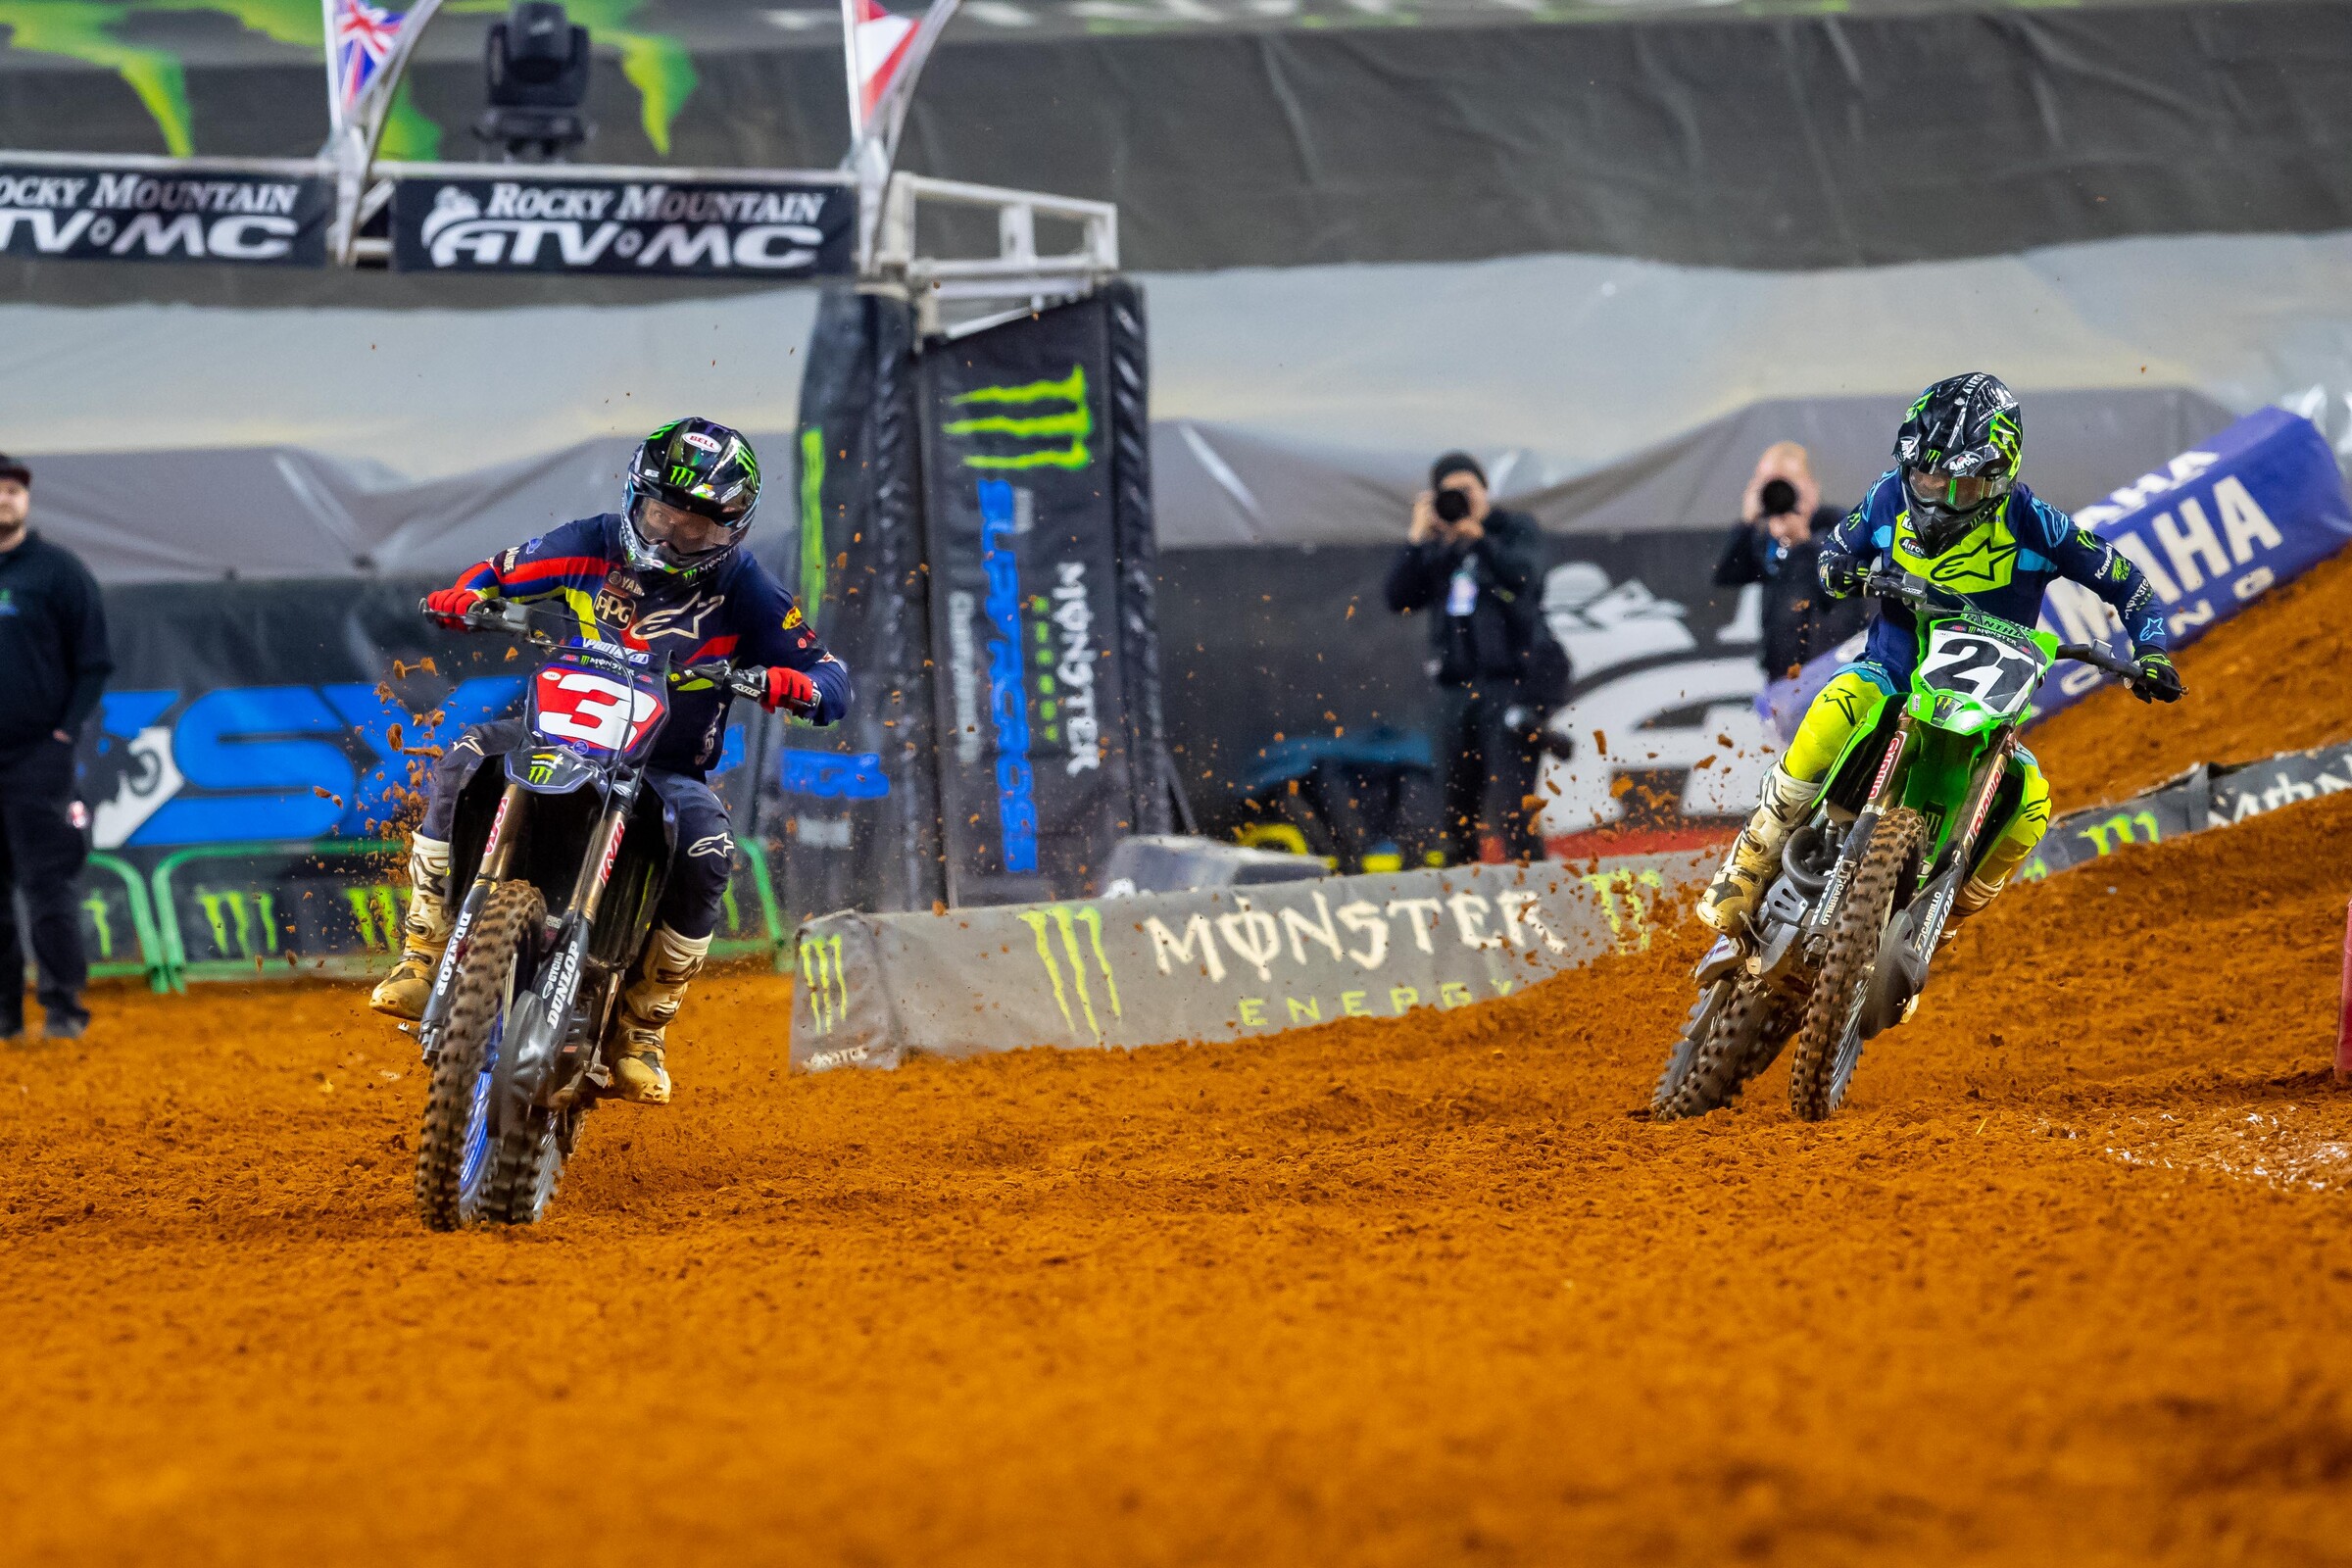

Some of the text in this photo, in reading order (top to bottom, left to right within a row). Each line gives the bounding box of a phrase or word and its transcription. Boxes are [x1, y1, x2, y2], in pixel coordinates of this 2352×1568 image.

[0, 173, 298, 214] OCKY MOUNTAIN
[486, 182, 825, 223] ROCKY MOUNTAIN
[689, 434, 715, 450] BELL
[595, 595, 630, 624] PPG
[1976, 627, 2019, 647] MONSTER
[1933, 638, 2036, 714] 21
[538, 673, 659, 752] 3
[1821, 884, 1844, 926] CARRILLO
[1920, 891, 1942, 936] CARRILLO
[436, 910, 472, 997] DUNLOP
[1144, 889, 1569, 983] MONSTER
[547, 941, 578, 1029] DUNLOP
